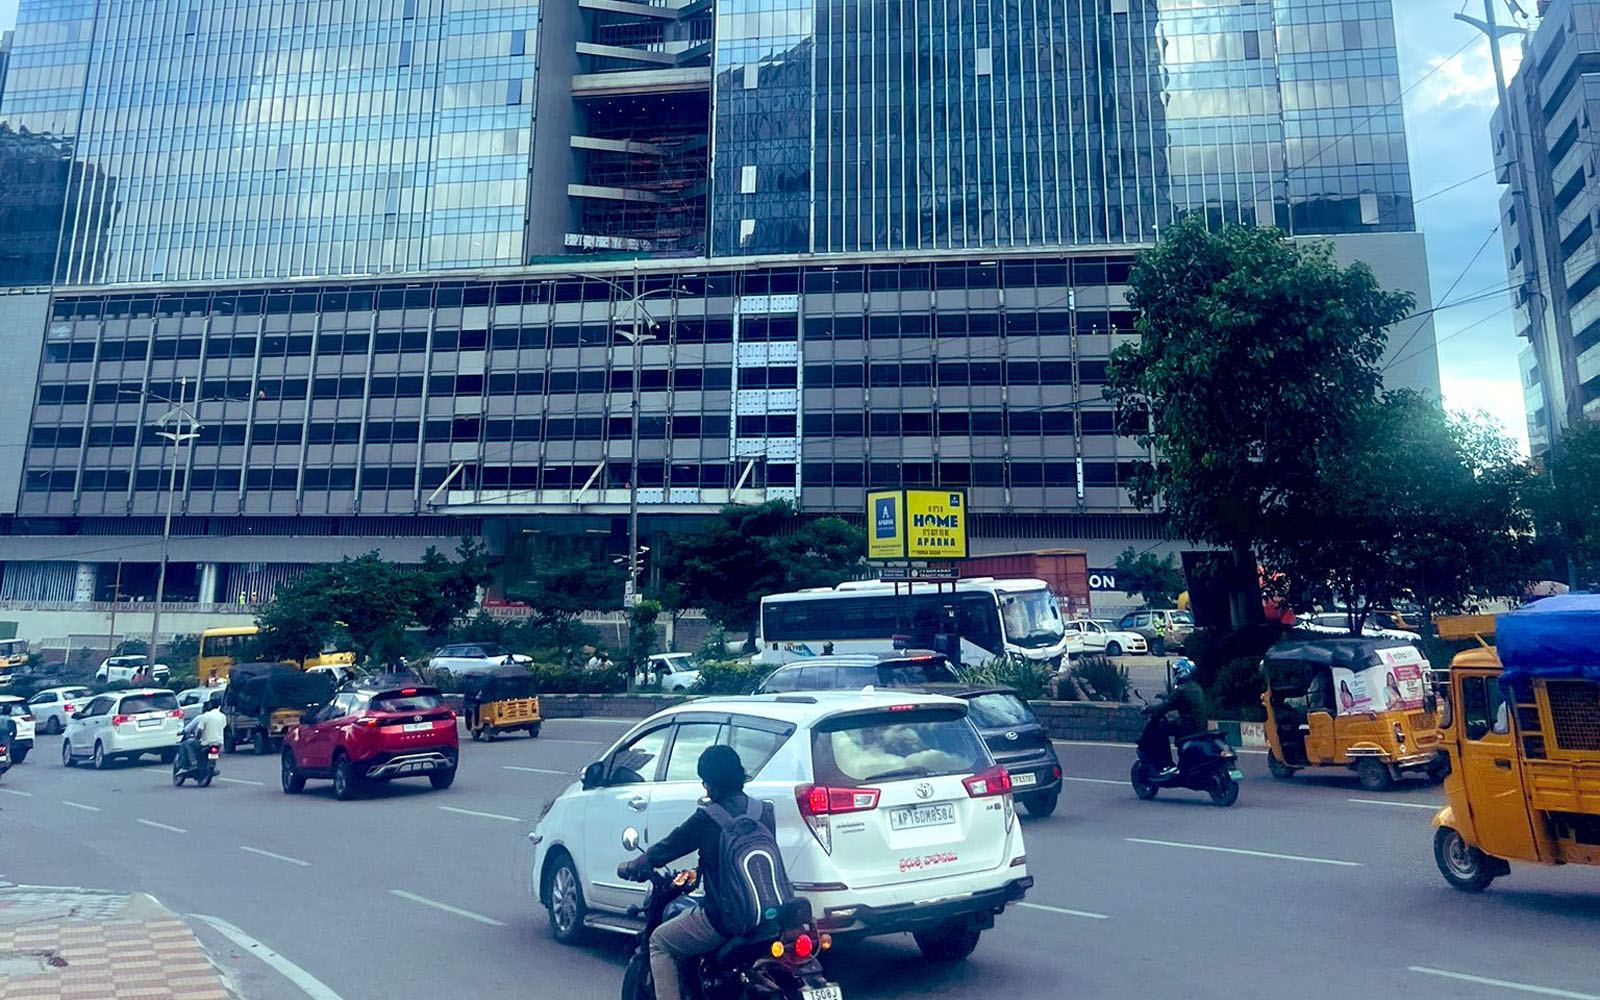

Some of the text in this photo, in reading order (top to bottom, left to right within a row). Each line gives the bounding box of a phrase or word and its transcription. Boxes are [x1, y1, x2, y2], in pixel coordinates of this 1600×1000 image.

[913, 514, 958, 528] HOME
[917, 537, 956, 547] APARNA
[1088, 574, 1115, 588] ON
